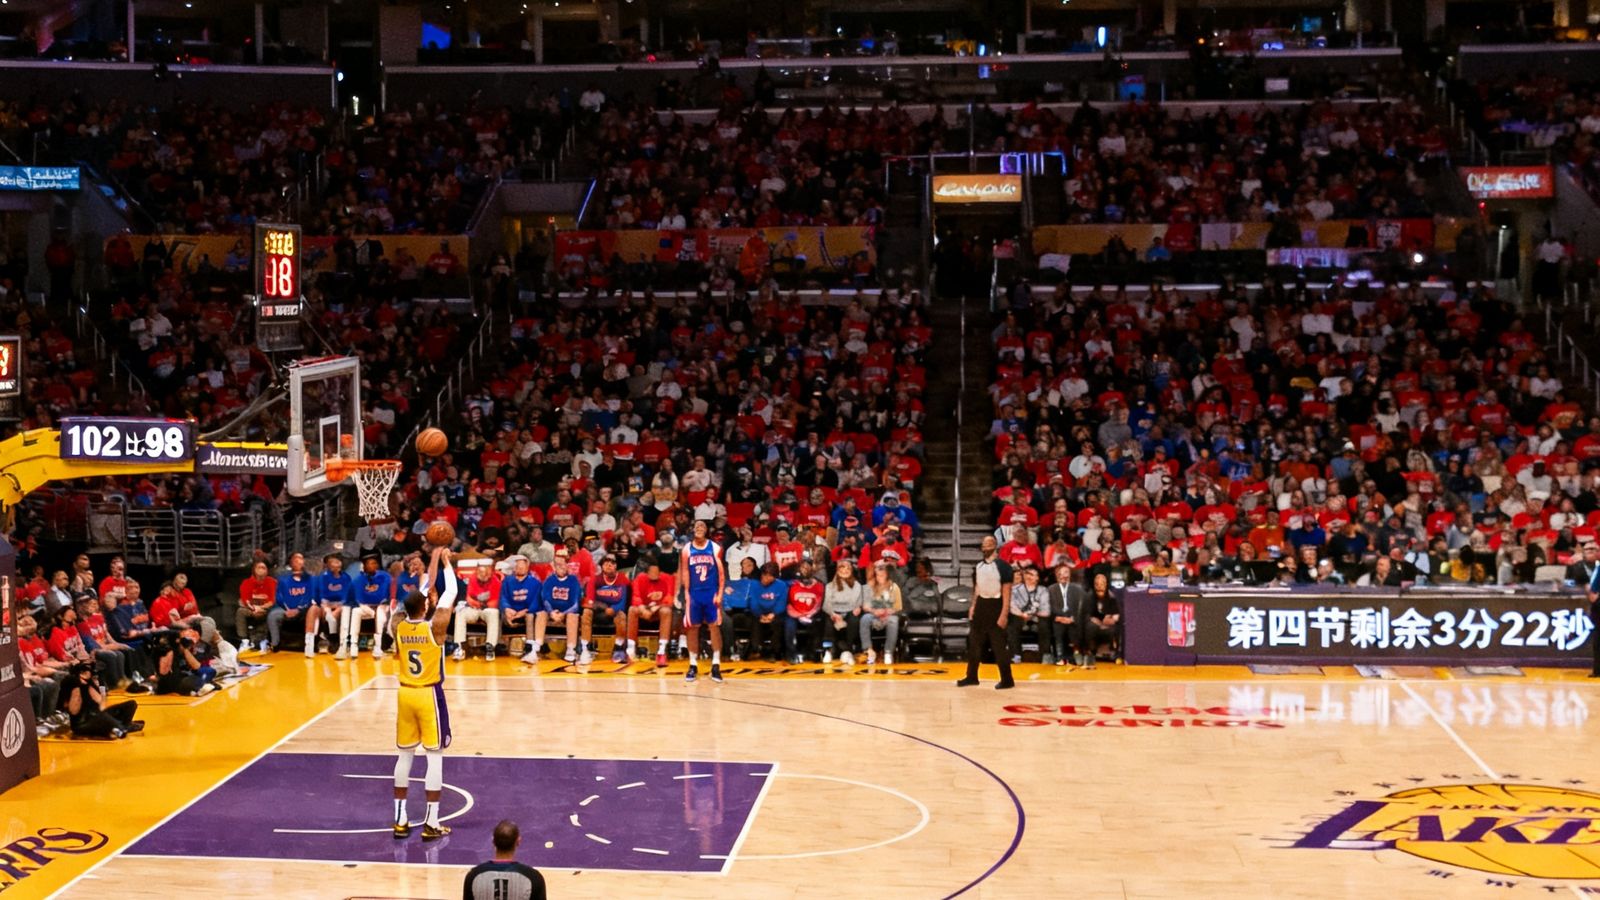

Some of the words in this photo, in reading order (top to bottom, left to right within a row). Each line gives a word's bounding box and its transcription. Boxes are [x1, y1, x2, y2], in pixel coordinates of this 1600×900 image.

[1226, 606, 1594, 650] 第四节剩余3分22秒
[408, 650, 422, 675] 5
